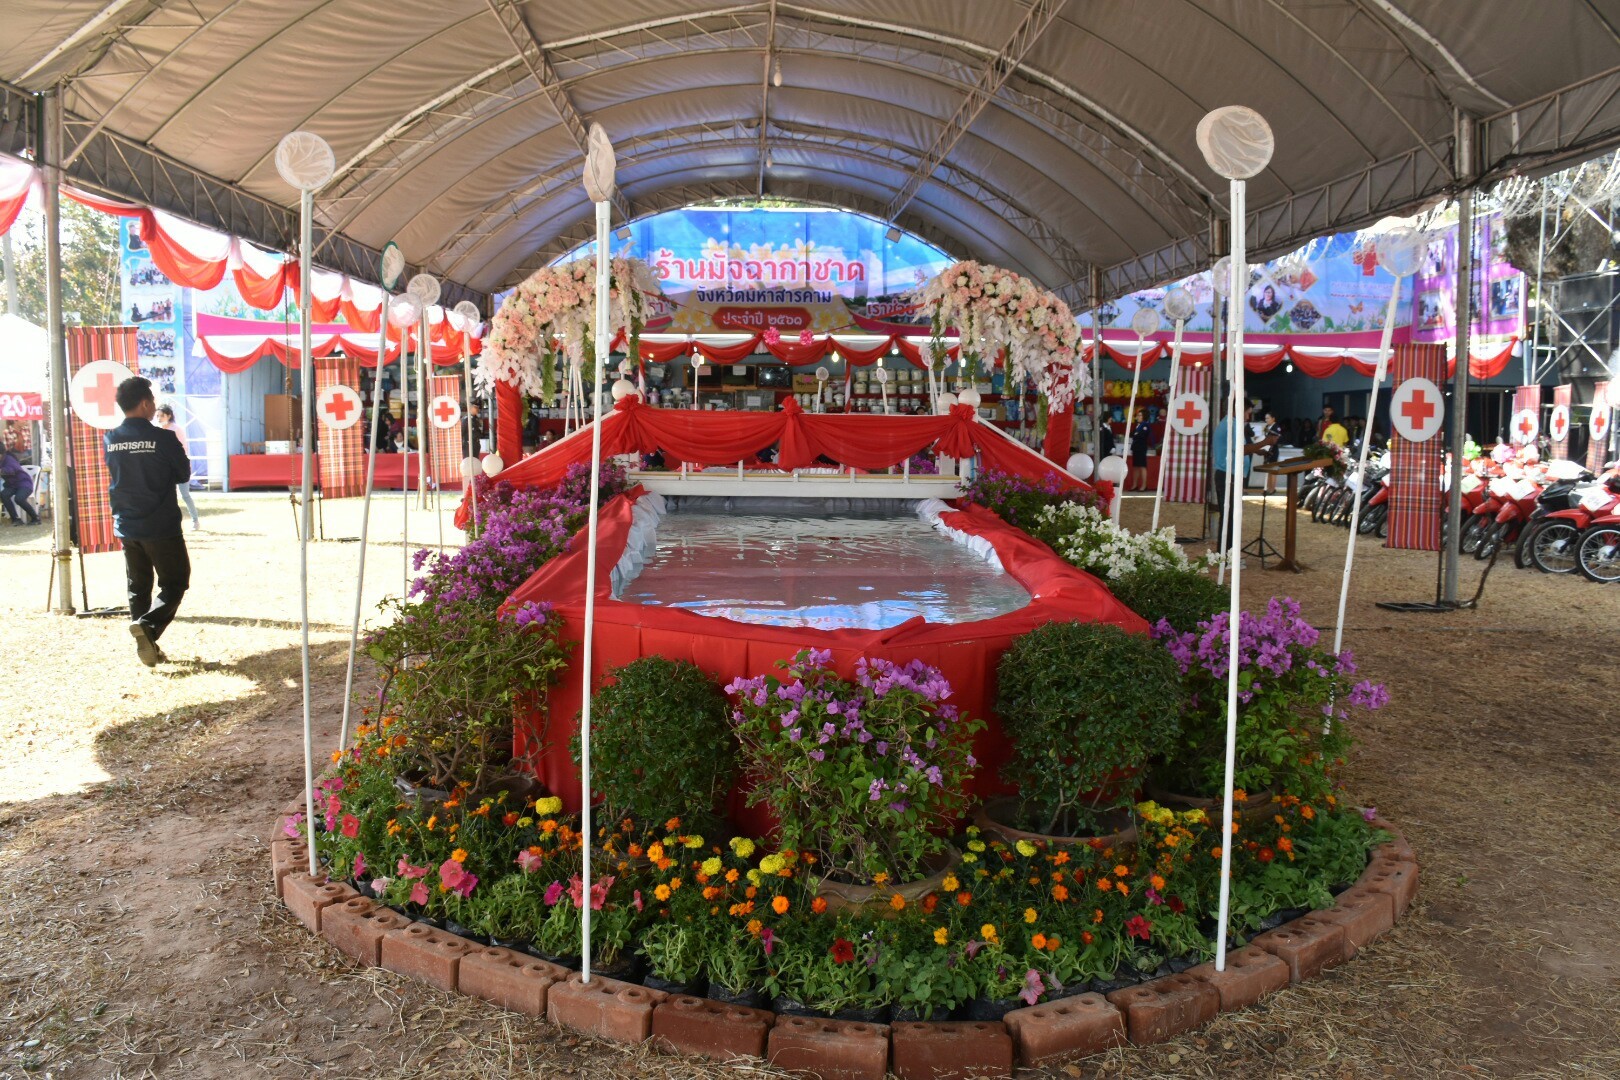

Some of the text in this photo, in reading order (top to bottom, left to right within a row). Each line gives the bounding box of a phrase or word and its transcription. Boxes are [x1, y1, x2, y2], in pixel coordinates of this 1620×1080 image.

[655, 248, 866, 281] ร้านมัจฉากาชาด
[696, 286, 832, 304] จังหวัดมหาสารคาม
[722, 311, 763, 325] ประจำปี
[107, 440, 156, 452] มหาสารคาม
